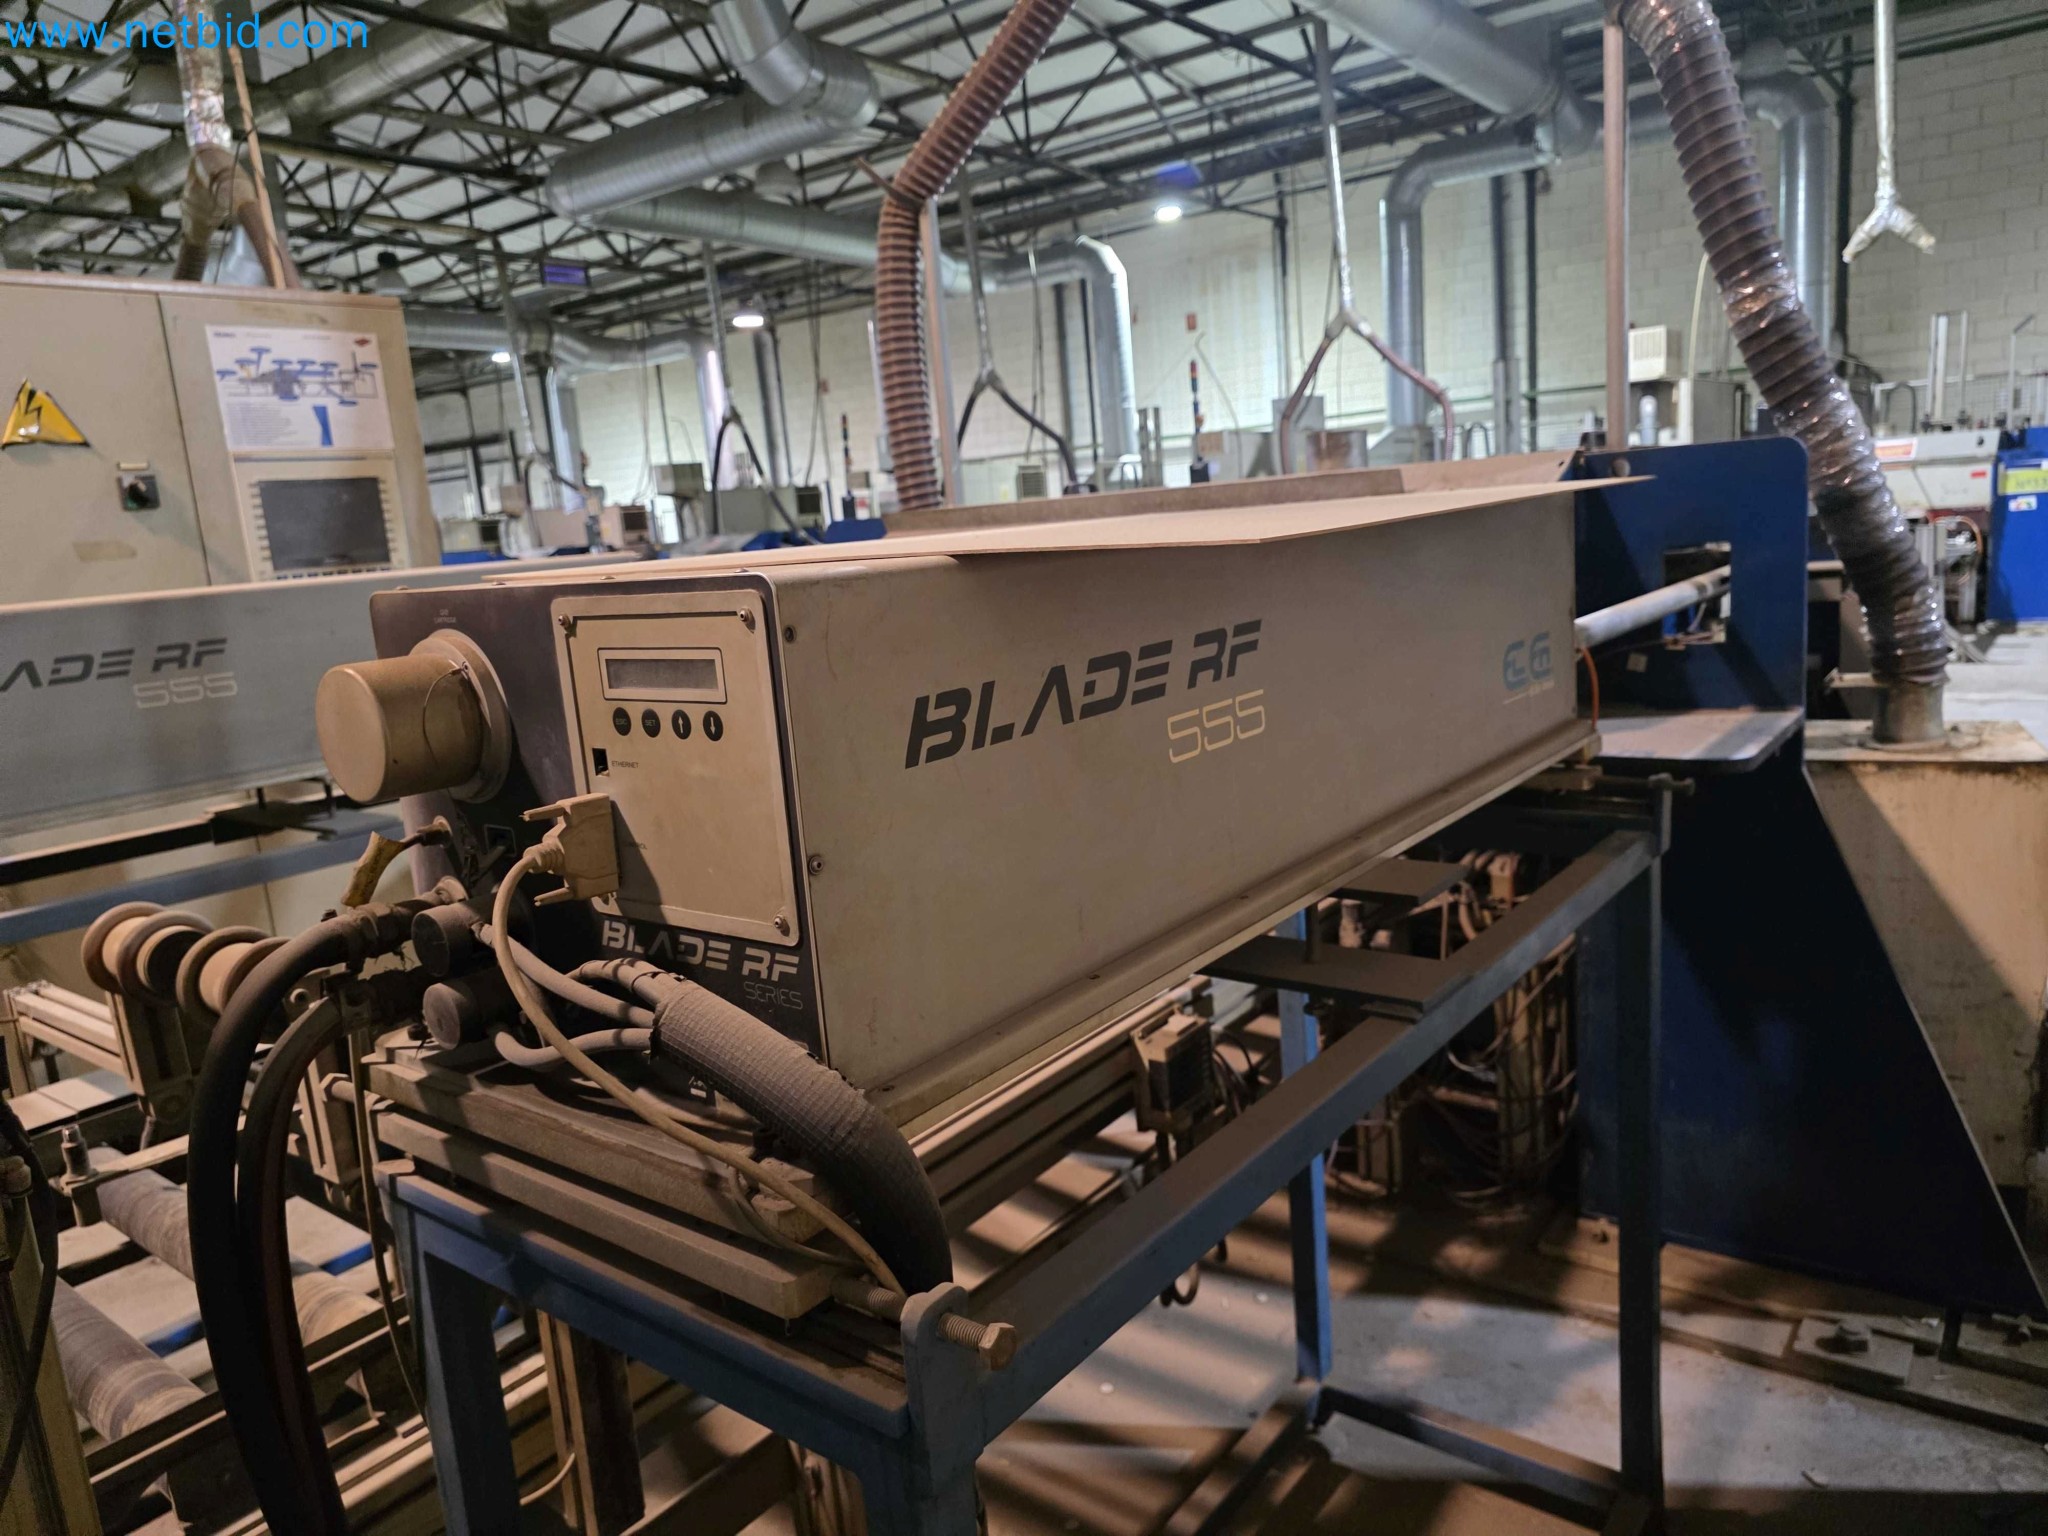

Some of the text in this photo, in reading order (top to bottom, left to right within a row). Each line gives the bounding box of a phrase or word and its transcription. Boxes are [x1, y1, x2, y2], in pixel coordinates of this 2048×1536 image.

[151, 638, 228, 673] RF
[905, 619, 1262, 769] BLADE RF
[611, 760, 639, 769] ETHERNET
[601, 919, 799, 982] BLADE RF
[743, 981, 803, 1010] SERIES
